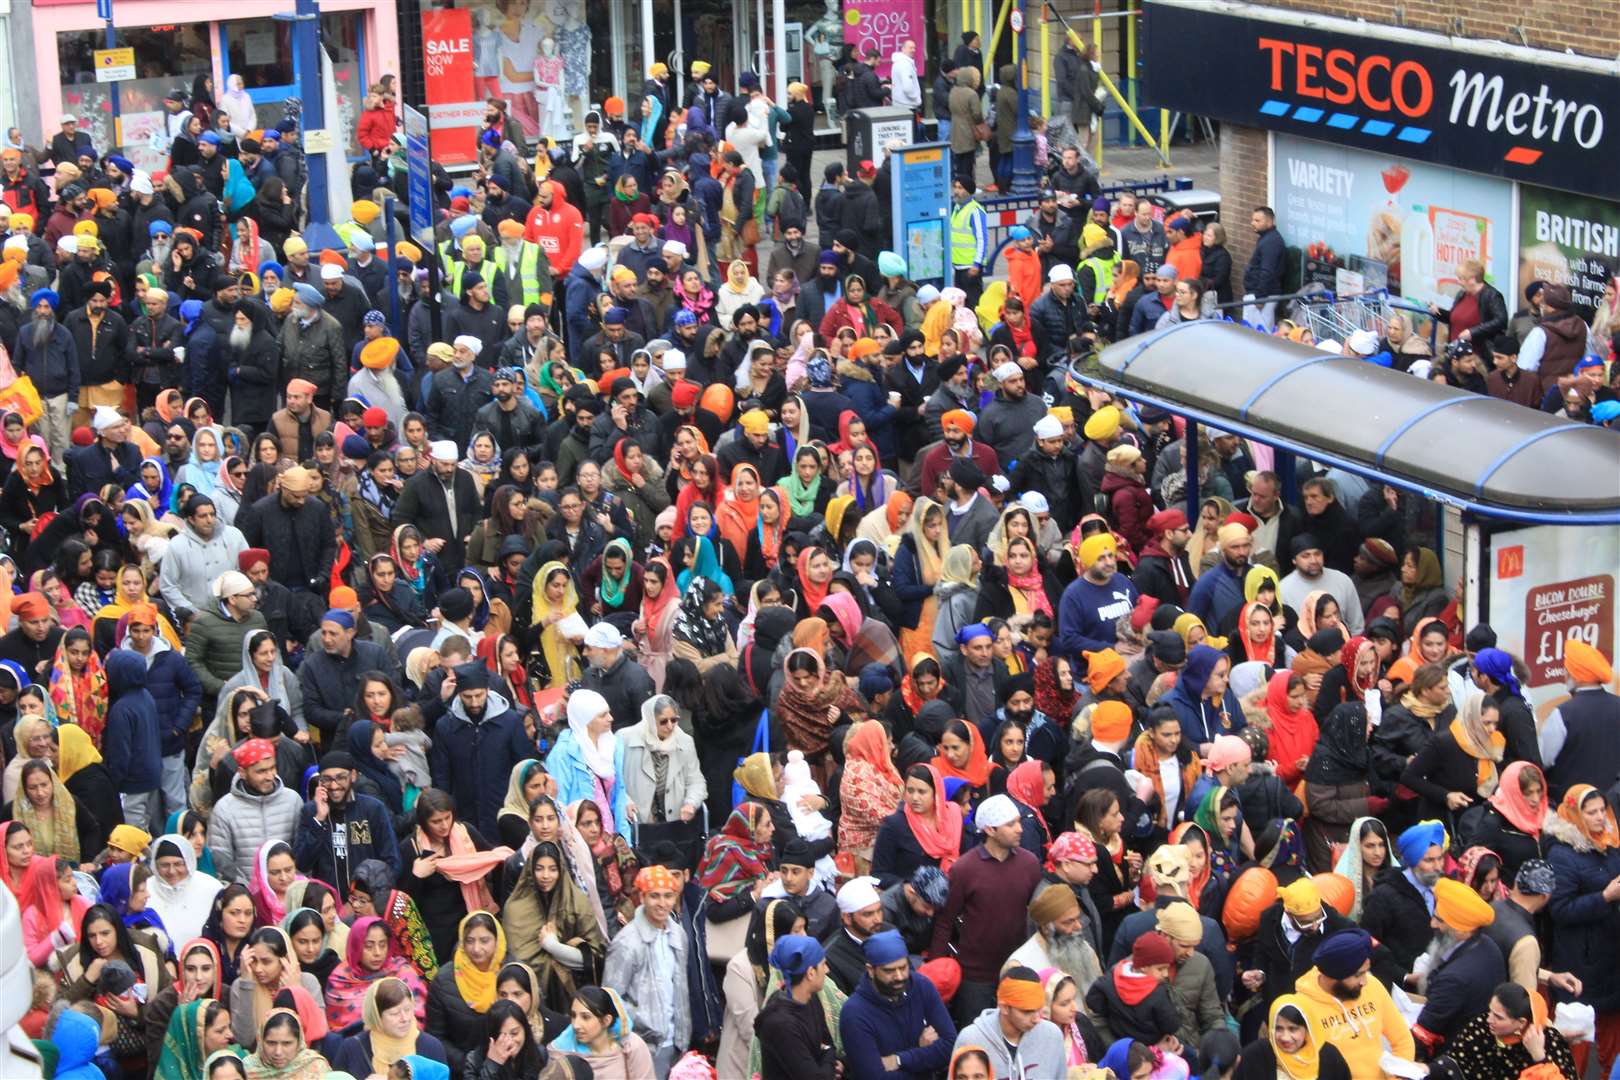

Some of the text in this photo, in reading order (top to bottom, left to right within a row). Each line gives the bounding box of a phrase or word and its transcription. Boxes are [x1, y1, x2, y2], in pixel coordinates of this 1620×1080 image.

[426, 38, 470, 55] SALE
[860, 33, 910, 57] OFF
[427, 54, 453, 66] NOW
[427, 65, 444, 77] ON
[1259, 37, 1604, 150] TESCO Metro
[1288, 157, 1354, 199] VARIETY
[1536, 210, 1619, 257] BRITISH
[1436, 241, 1456, 265] HOT
[1570, 257, 1605, 277] with the
[1582, 275, 1607, 294] farme
[1571, 289, 1592, 305] from
[1535, 582, 1605, 608] BACON DOUBLE
[1097, 600, 1131, 622] PUMA
[1538, 603, 1601, 626] Cheeseburger
